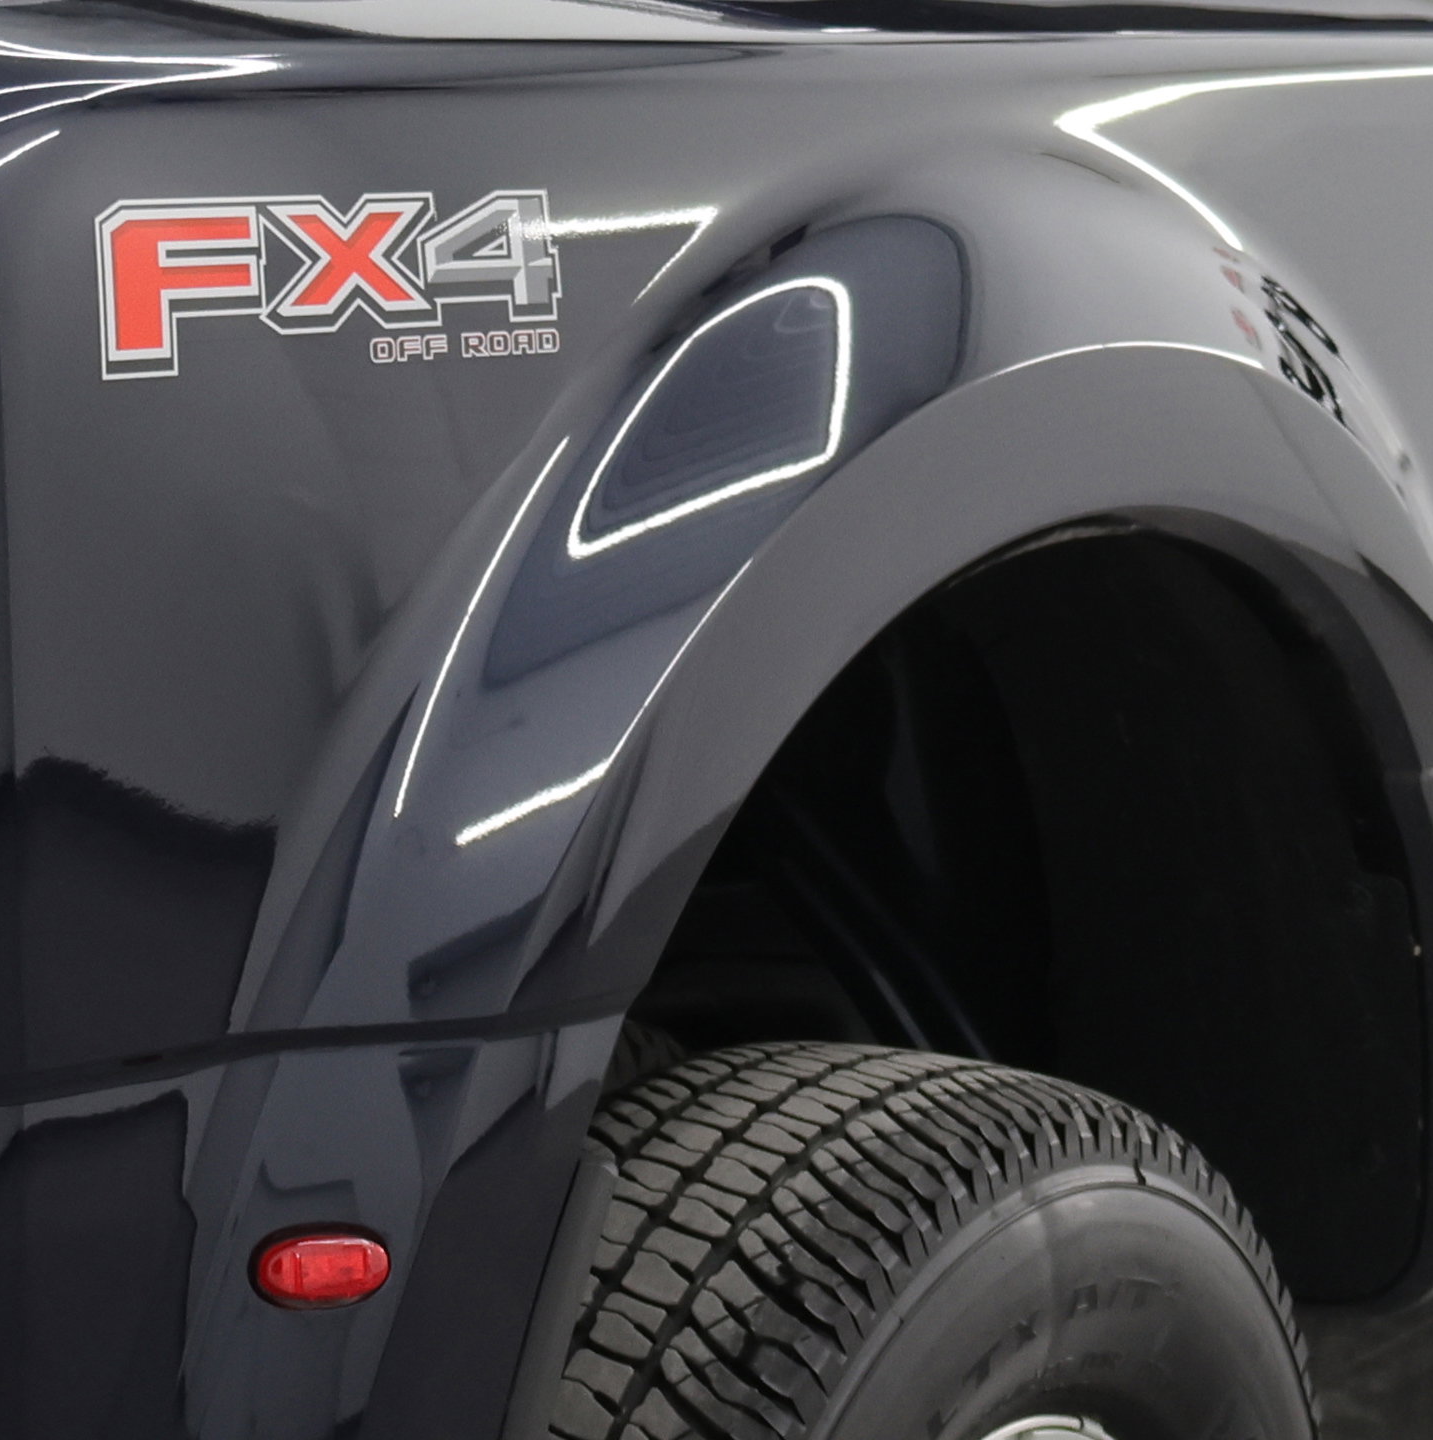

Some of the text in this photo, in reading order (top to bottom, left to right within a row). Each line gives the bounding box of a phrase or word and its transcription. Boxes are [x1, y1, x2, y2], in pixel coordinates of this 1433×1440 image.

[95, 189, 562, 381] FX4
[369, 328, 561, 364] OFF ROAD
